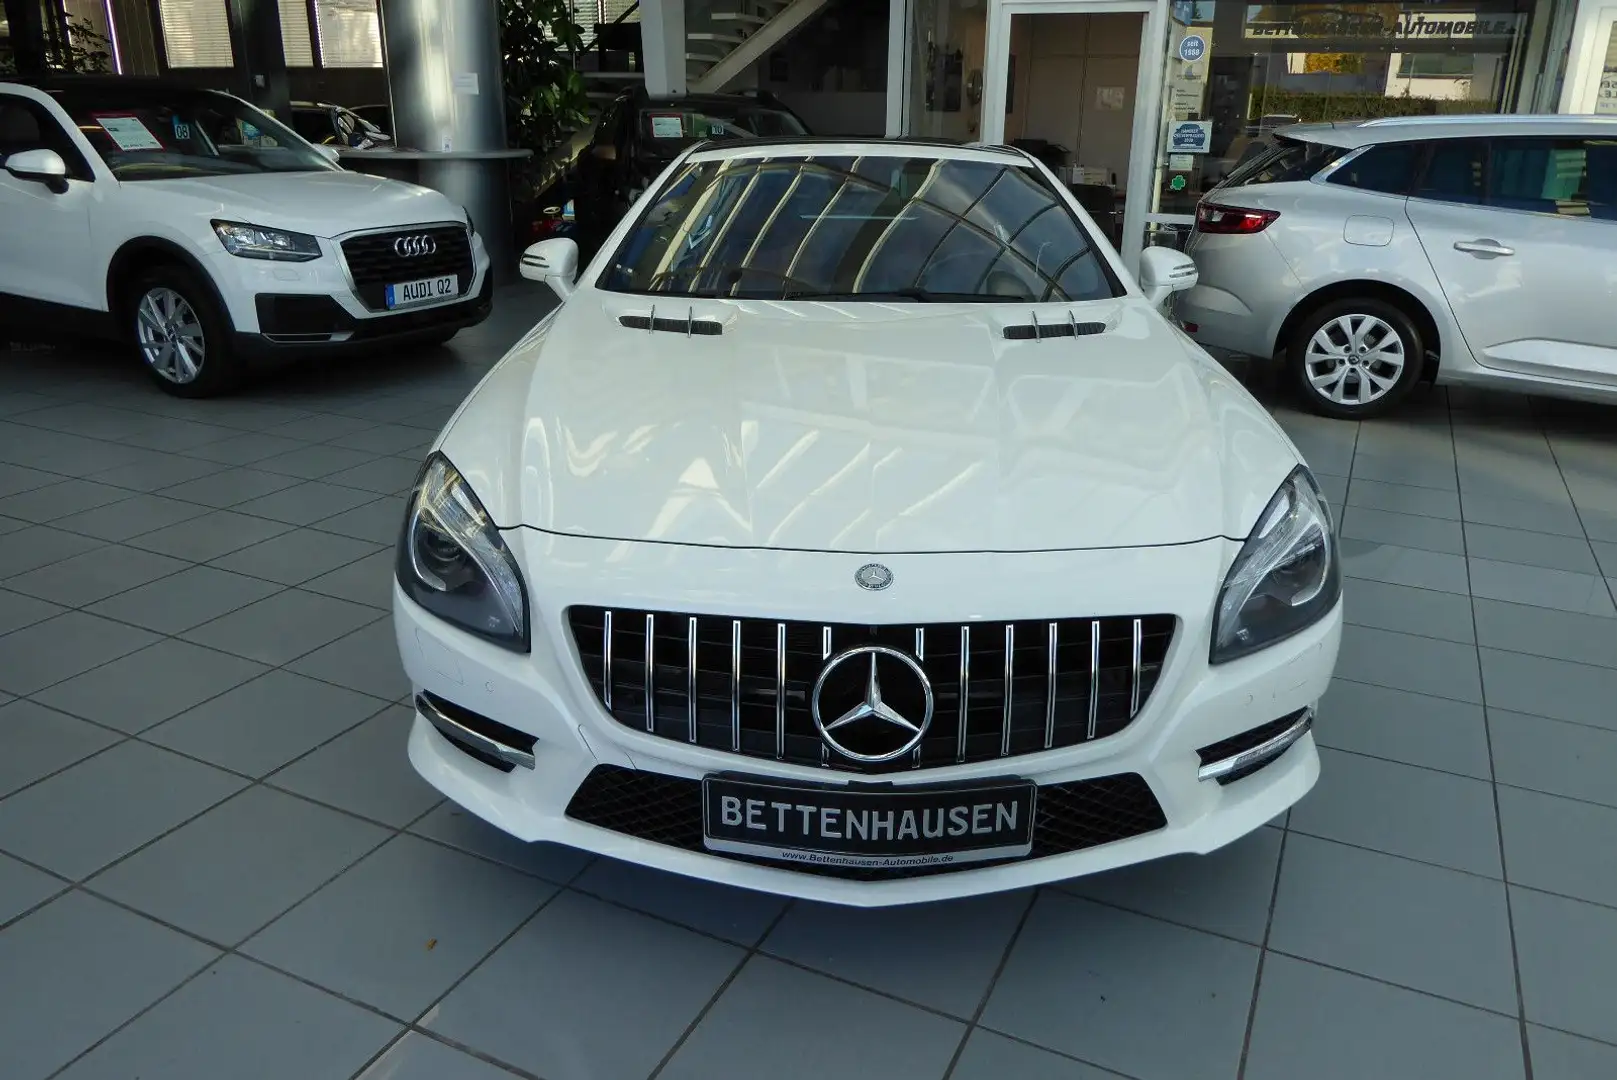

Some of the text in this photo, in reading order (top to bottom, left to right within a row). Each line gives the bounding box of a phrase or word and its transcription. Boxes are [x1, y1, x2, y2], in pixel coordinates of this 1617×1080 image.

[176, 125, 188, 138] 08
[403, 278, 452, 301] AUDI Q2
[721, 795, 1018, 840] BETTENHAUSEN
[781, 850, 954, 867] www.Bettenhausen-Automobile.de
